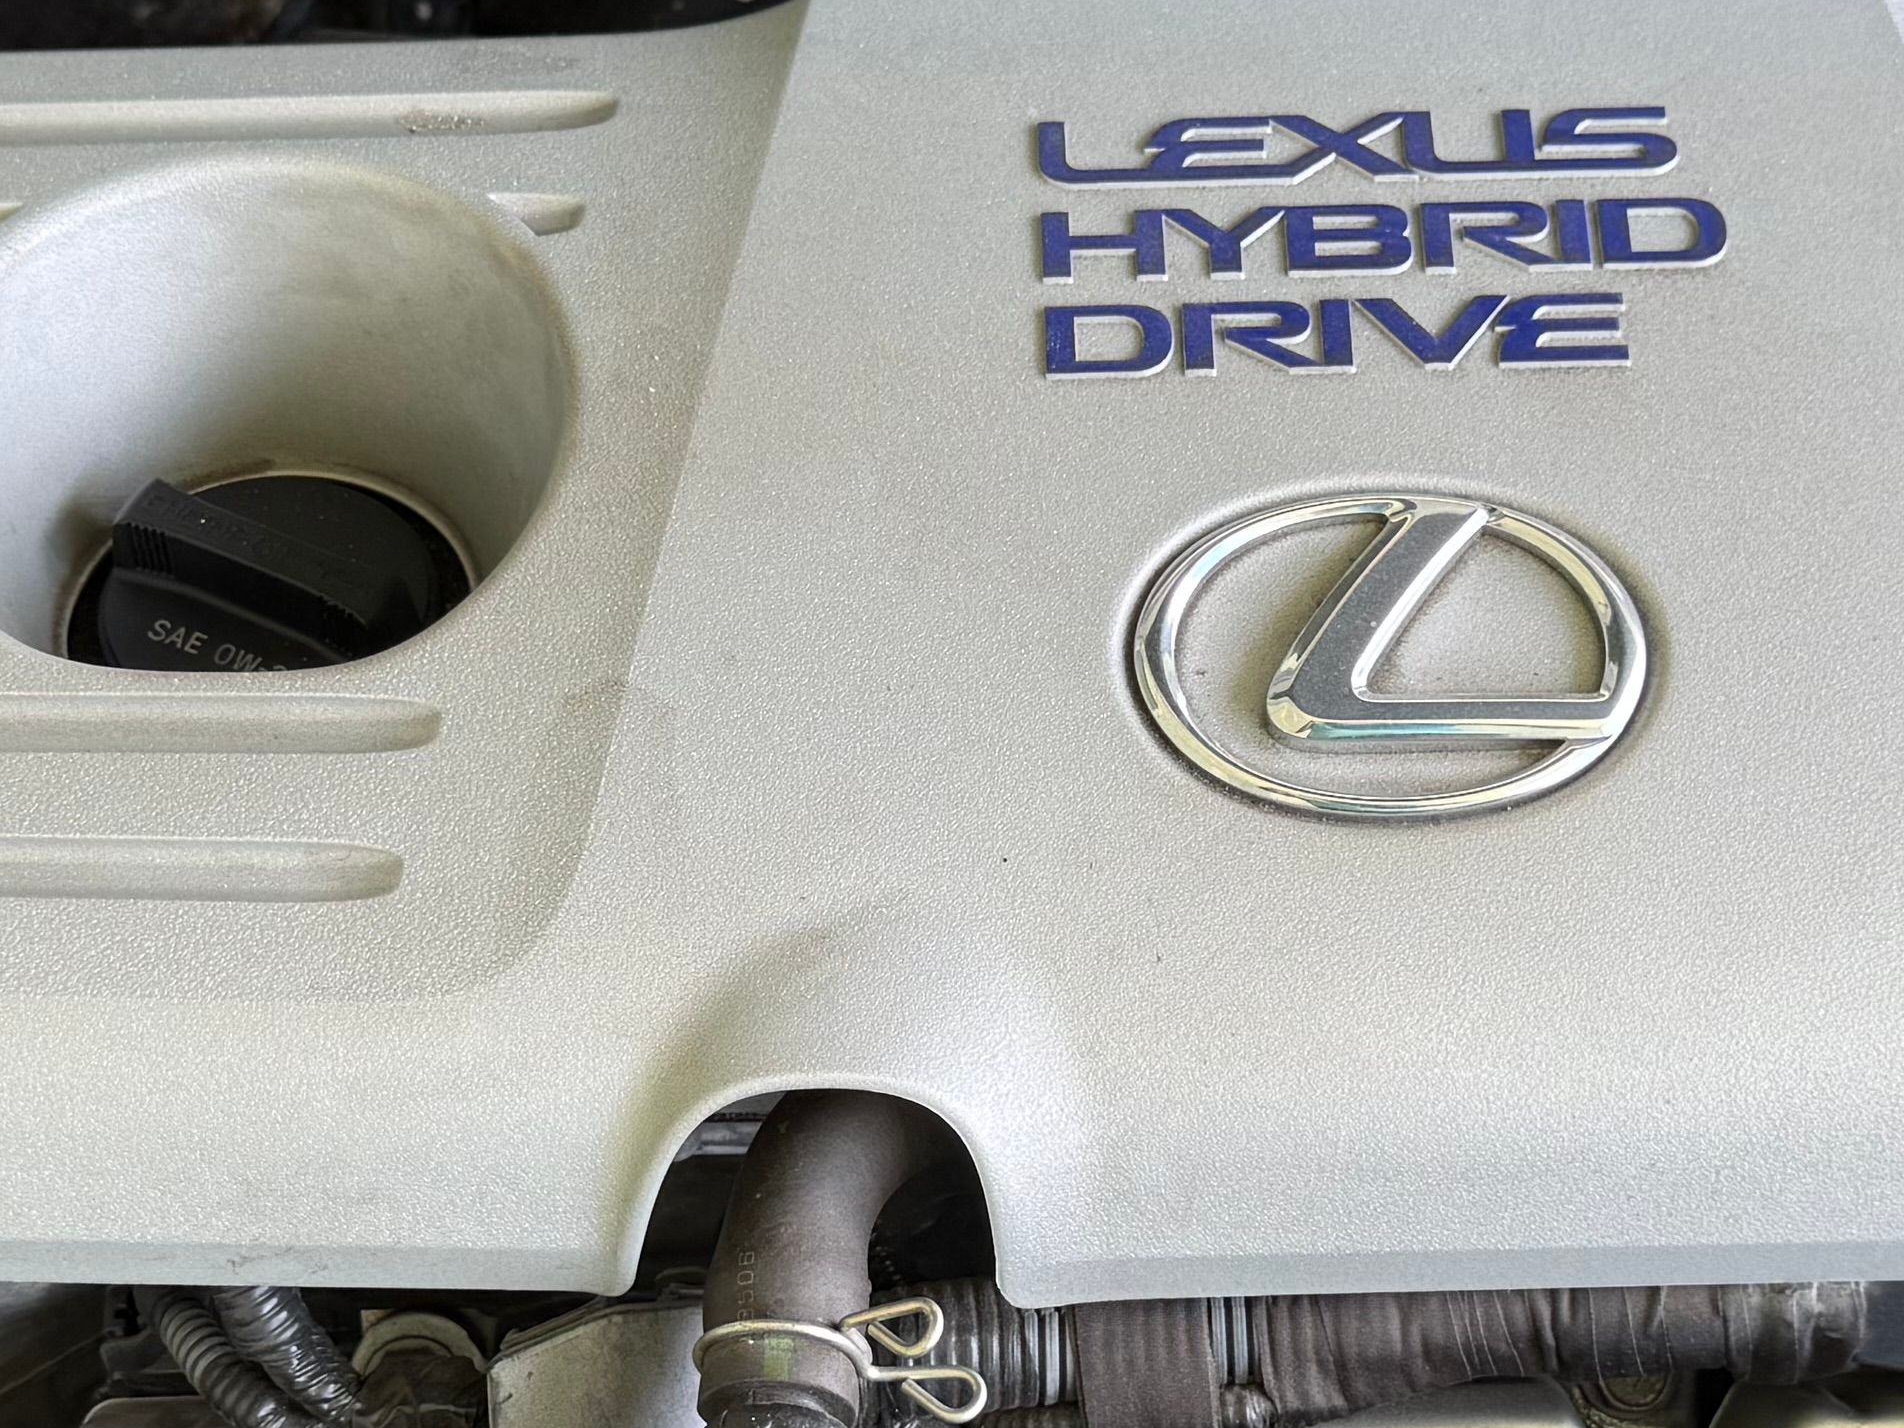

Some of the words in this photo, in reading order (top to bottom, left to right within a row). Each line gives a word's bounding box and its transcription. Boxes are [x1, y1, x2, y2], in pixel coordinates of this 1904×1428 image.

[1037, 106, 1680, 189] LEXUS
[1040, 197, 1728, 284] HYBRID
[1044, 292, 1632, 379] DRIVE
[147, 619, 209, 655] SAE
